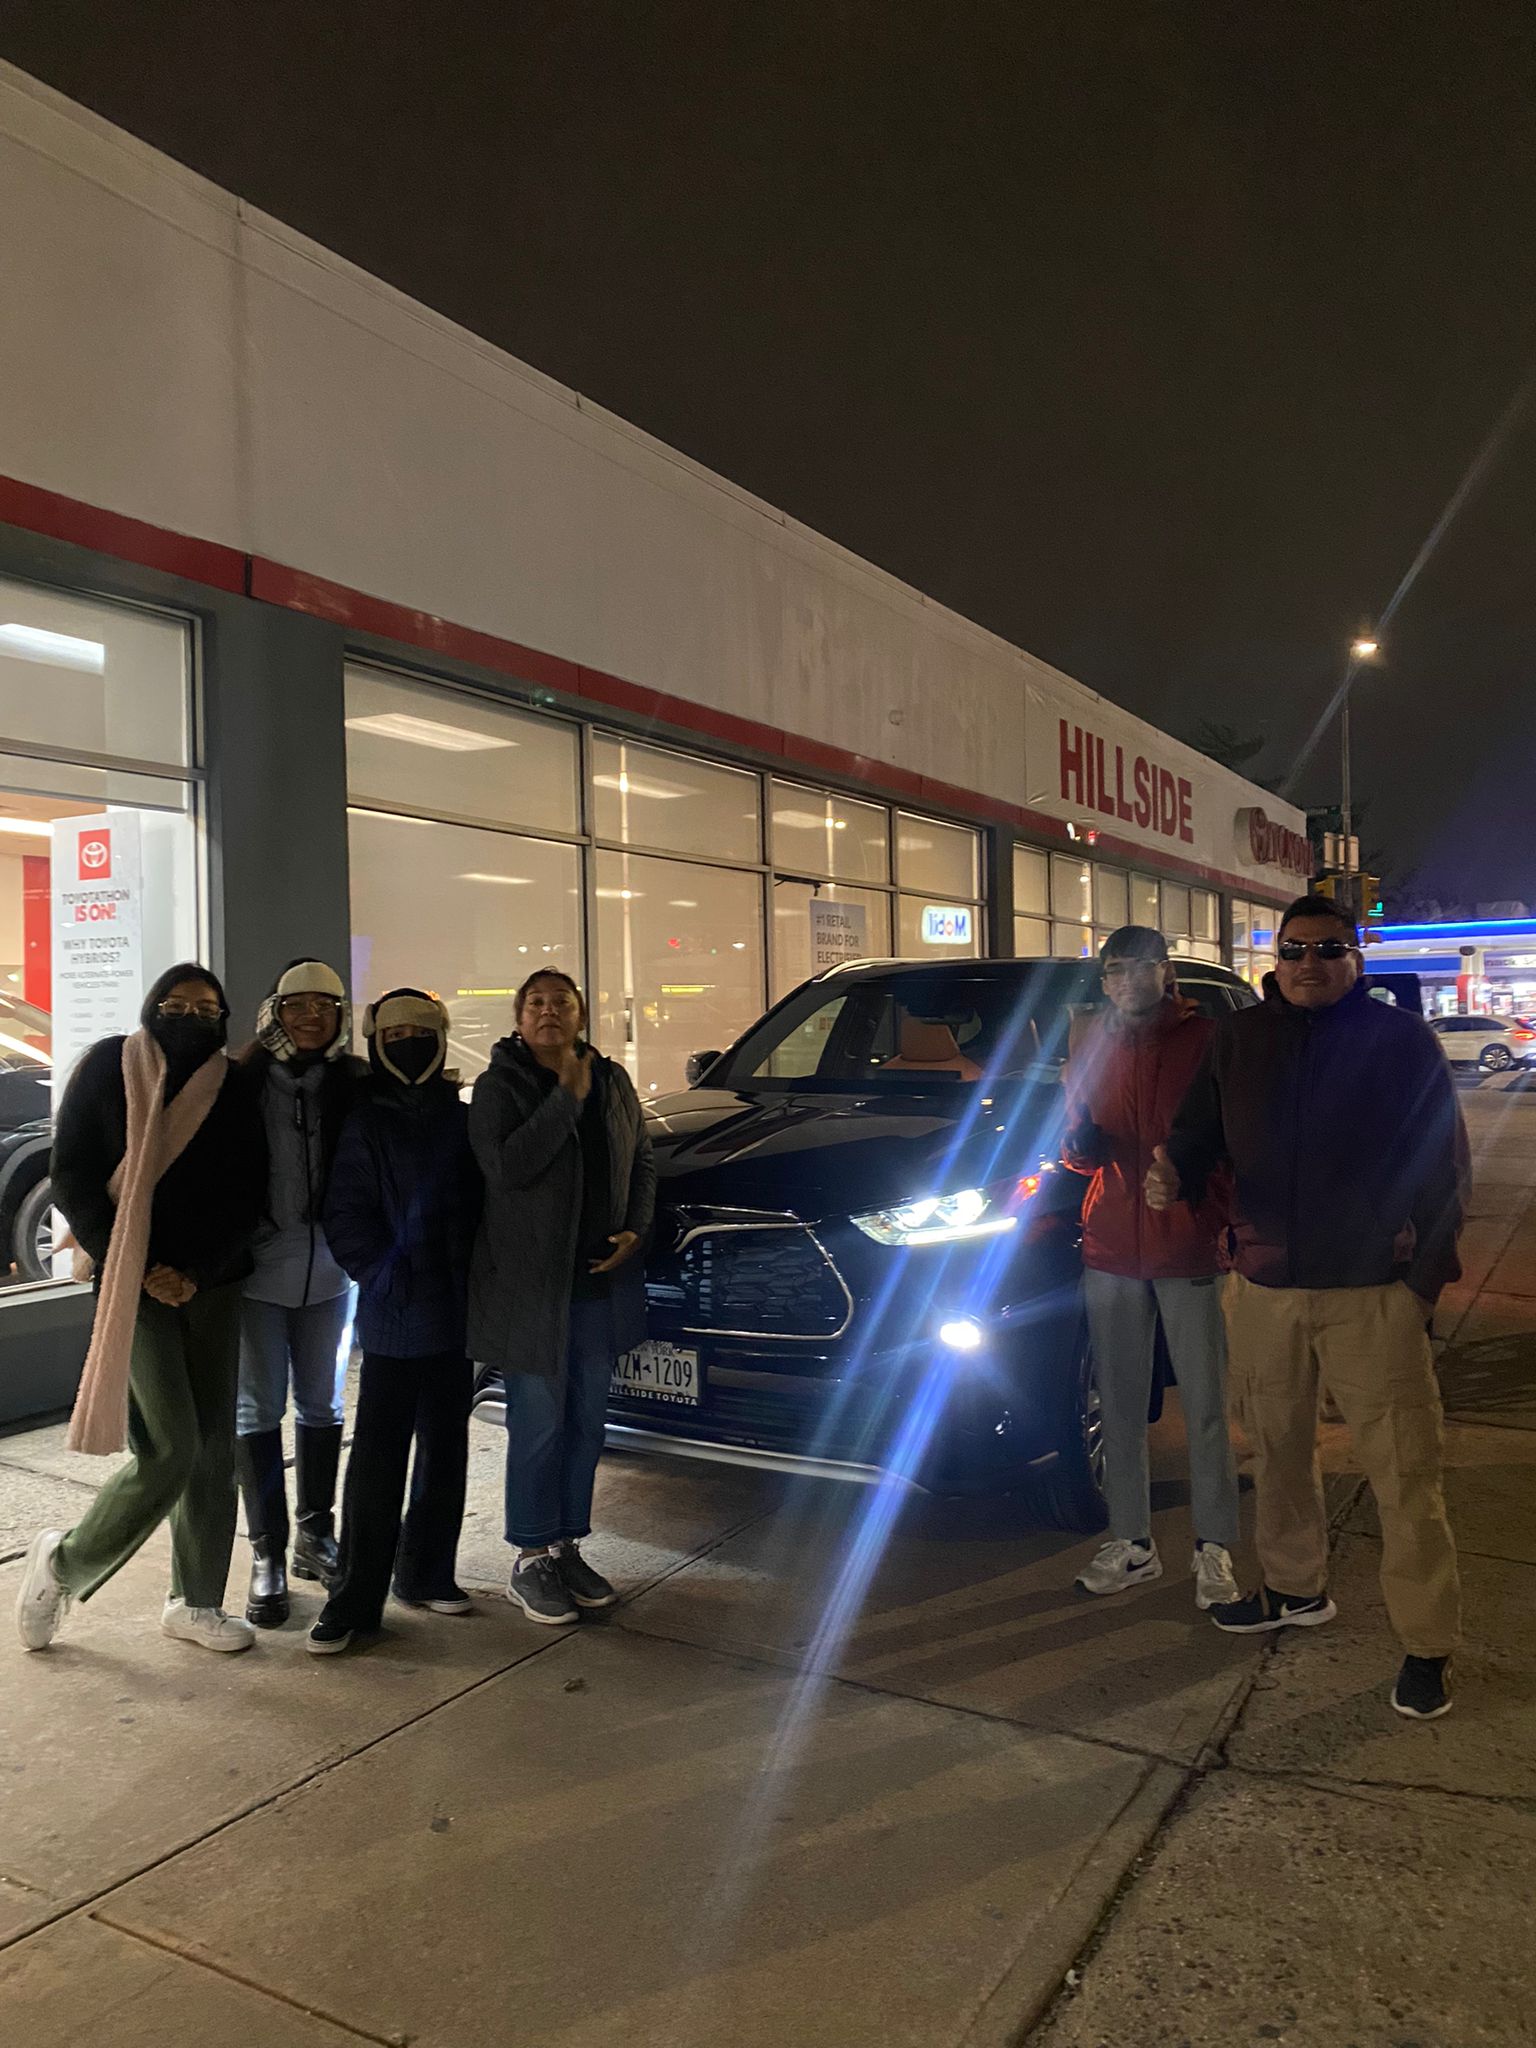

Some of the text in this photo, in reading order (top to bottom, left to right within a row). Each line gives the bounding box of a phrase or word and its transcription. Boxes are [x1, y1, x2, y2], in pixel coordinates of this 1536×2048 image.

[1059, 718, 1194, 844] HILLSIDE
[62, 889, 130, 905] TOYOTATHON
[75, 903, 117, 922] IS ON!
[826, 914, 852, 929] RETAIL
[63, 937, 130, 950] WHY TOYOTA
[816, 931, 860, 947] BRAND FOR
[70, 952, 121, 964] HYBRIDS?
[656, 1393, 698, 1406] TOYOTA
